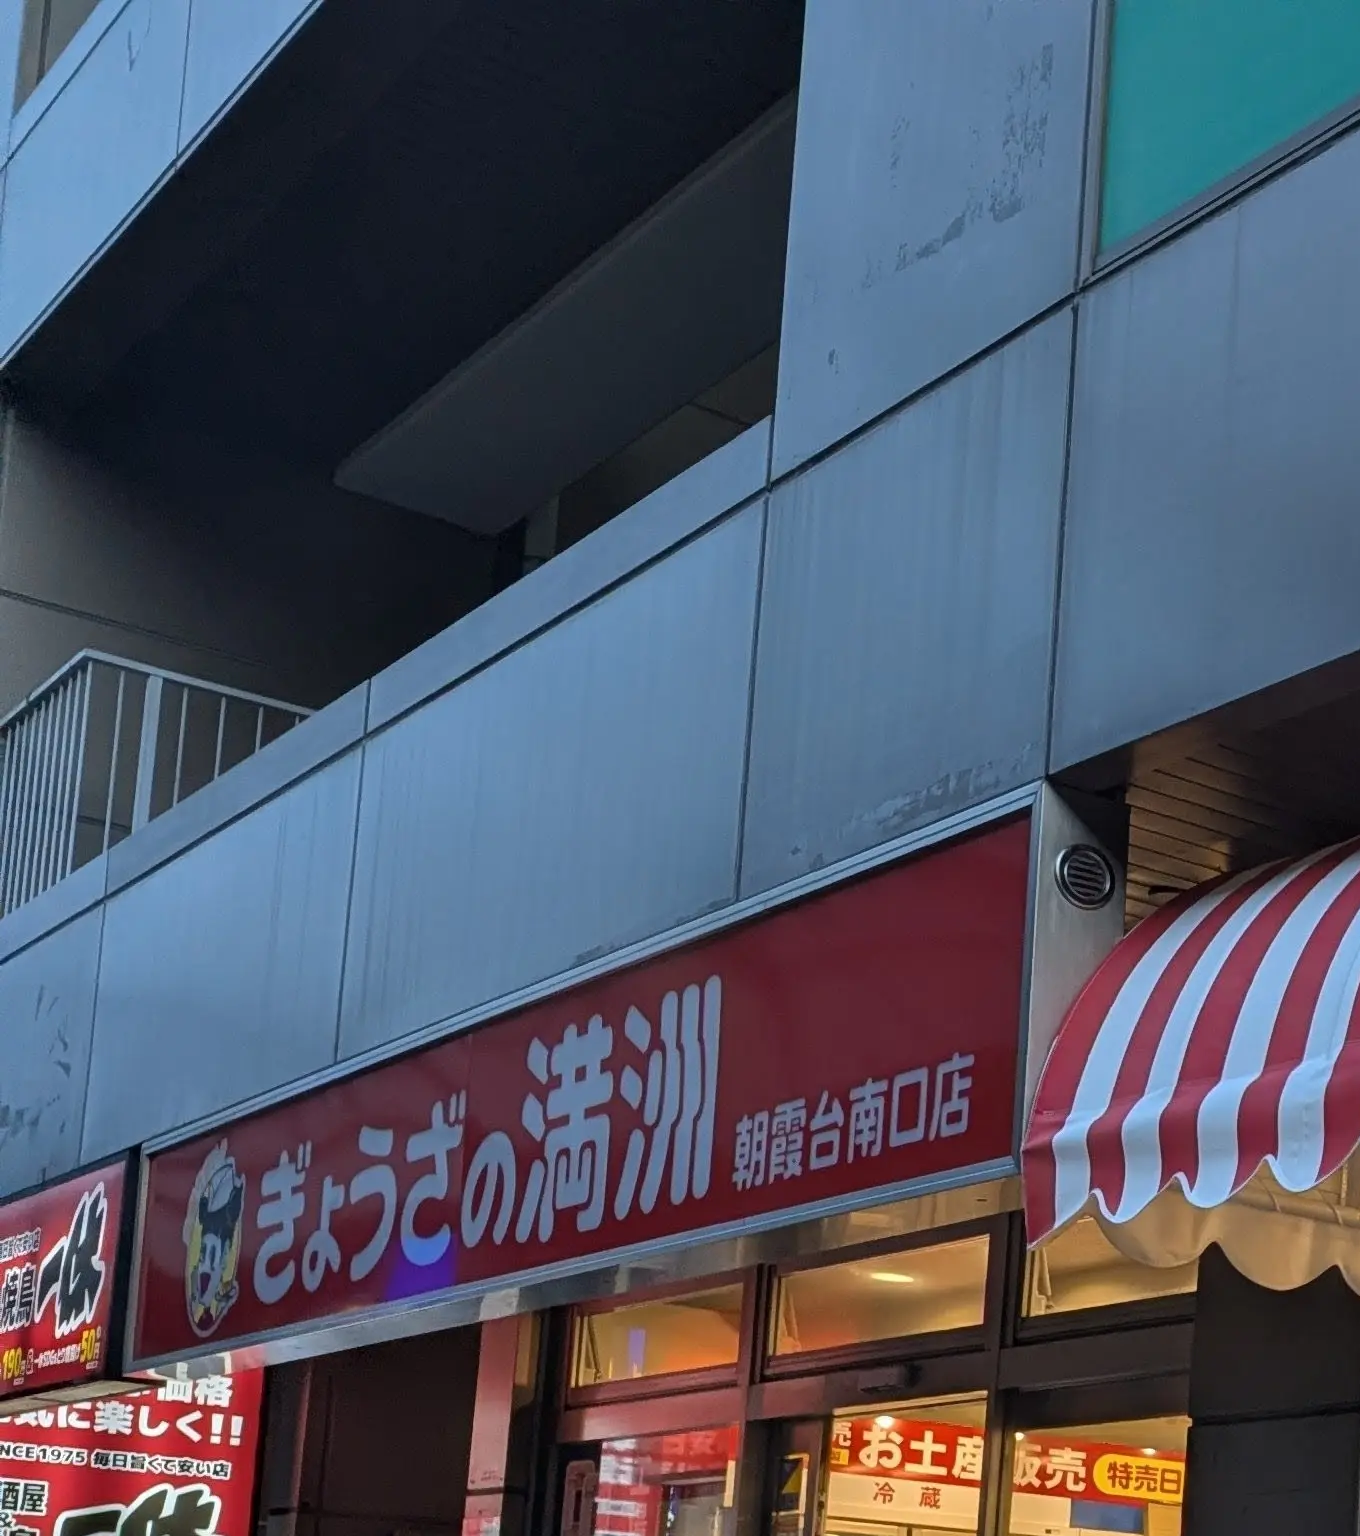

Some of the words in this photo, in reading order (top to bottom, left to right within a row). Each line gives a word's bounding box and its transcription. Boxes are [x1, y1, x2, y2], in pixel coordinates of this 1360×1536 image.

[253, 975, 722, 1306] ぎょうざの満洲
[731, 1053, 975, 1192] 朝霞台南口店
[873, 1481, 941, 1509] 冷蔵
[1107, 1461, 1182, 1495] 特売日
